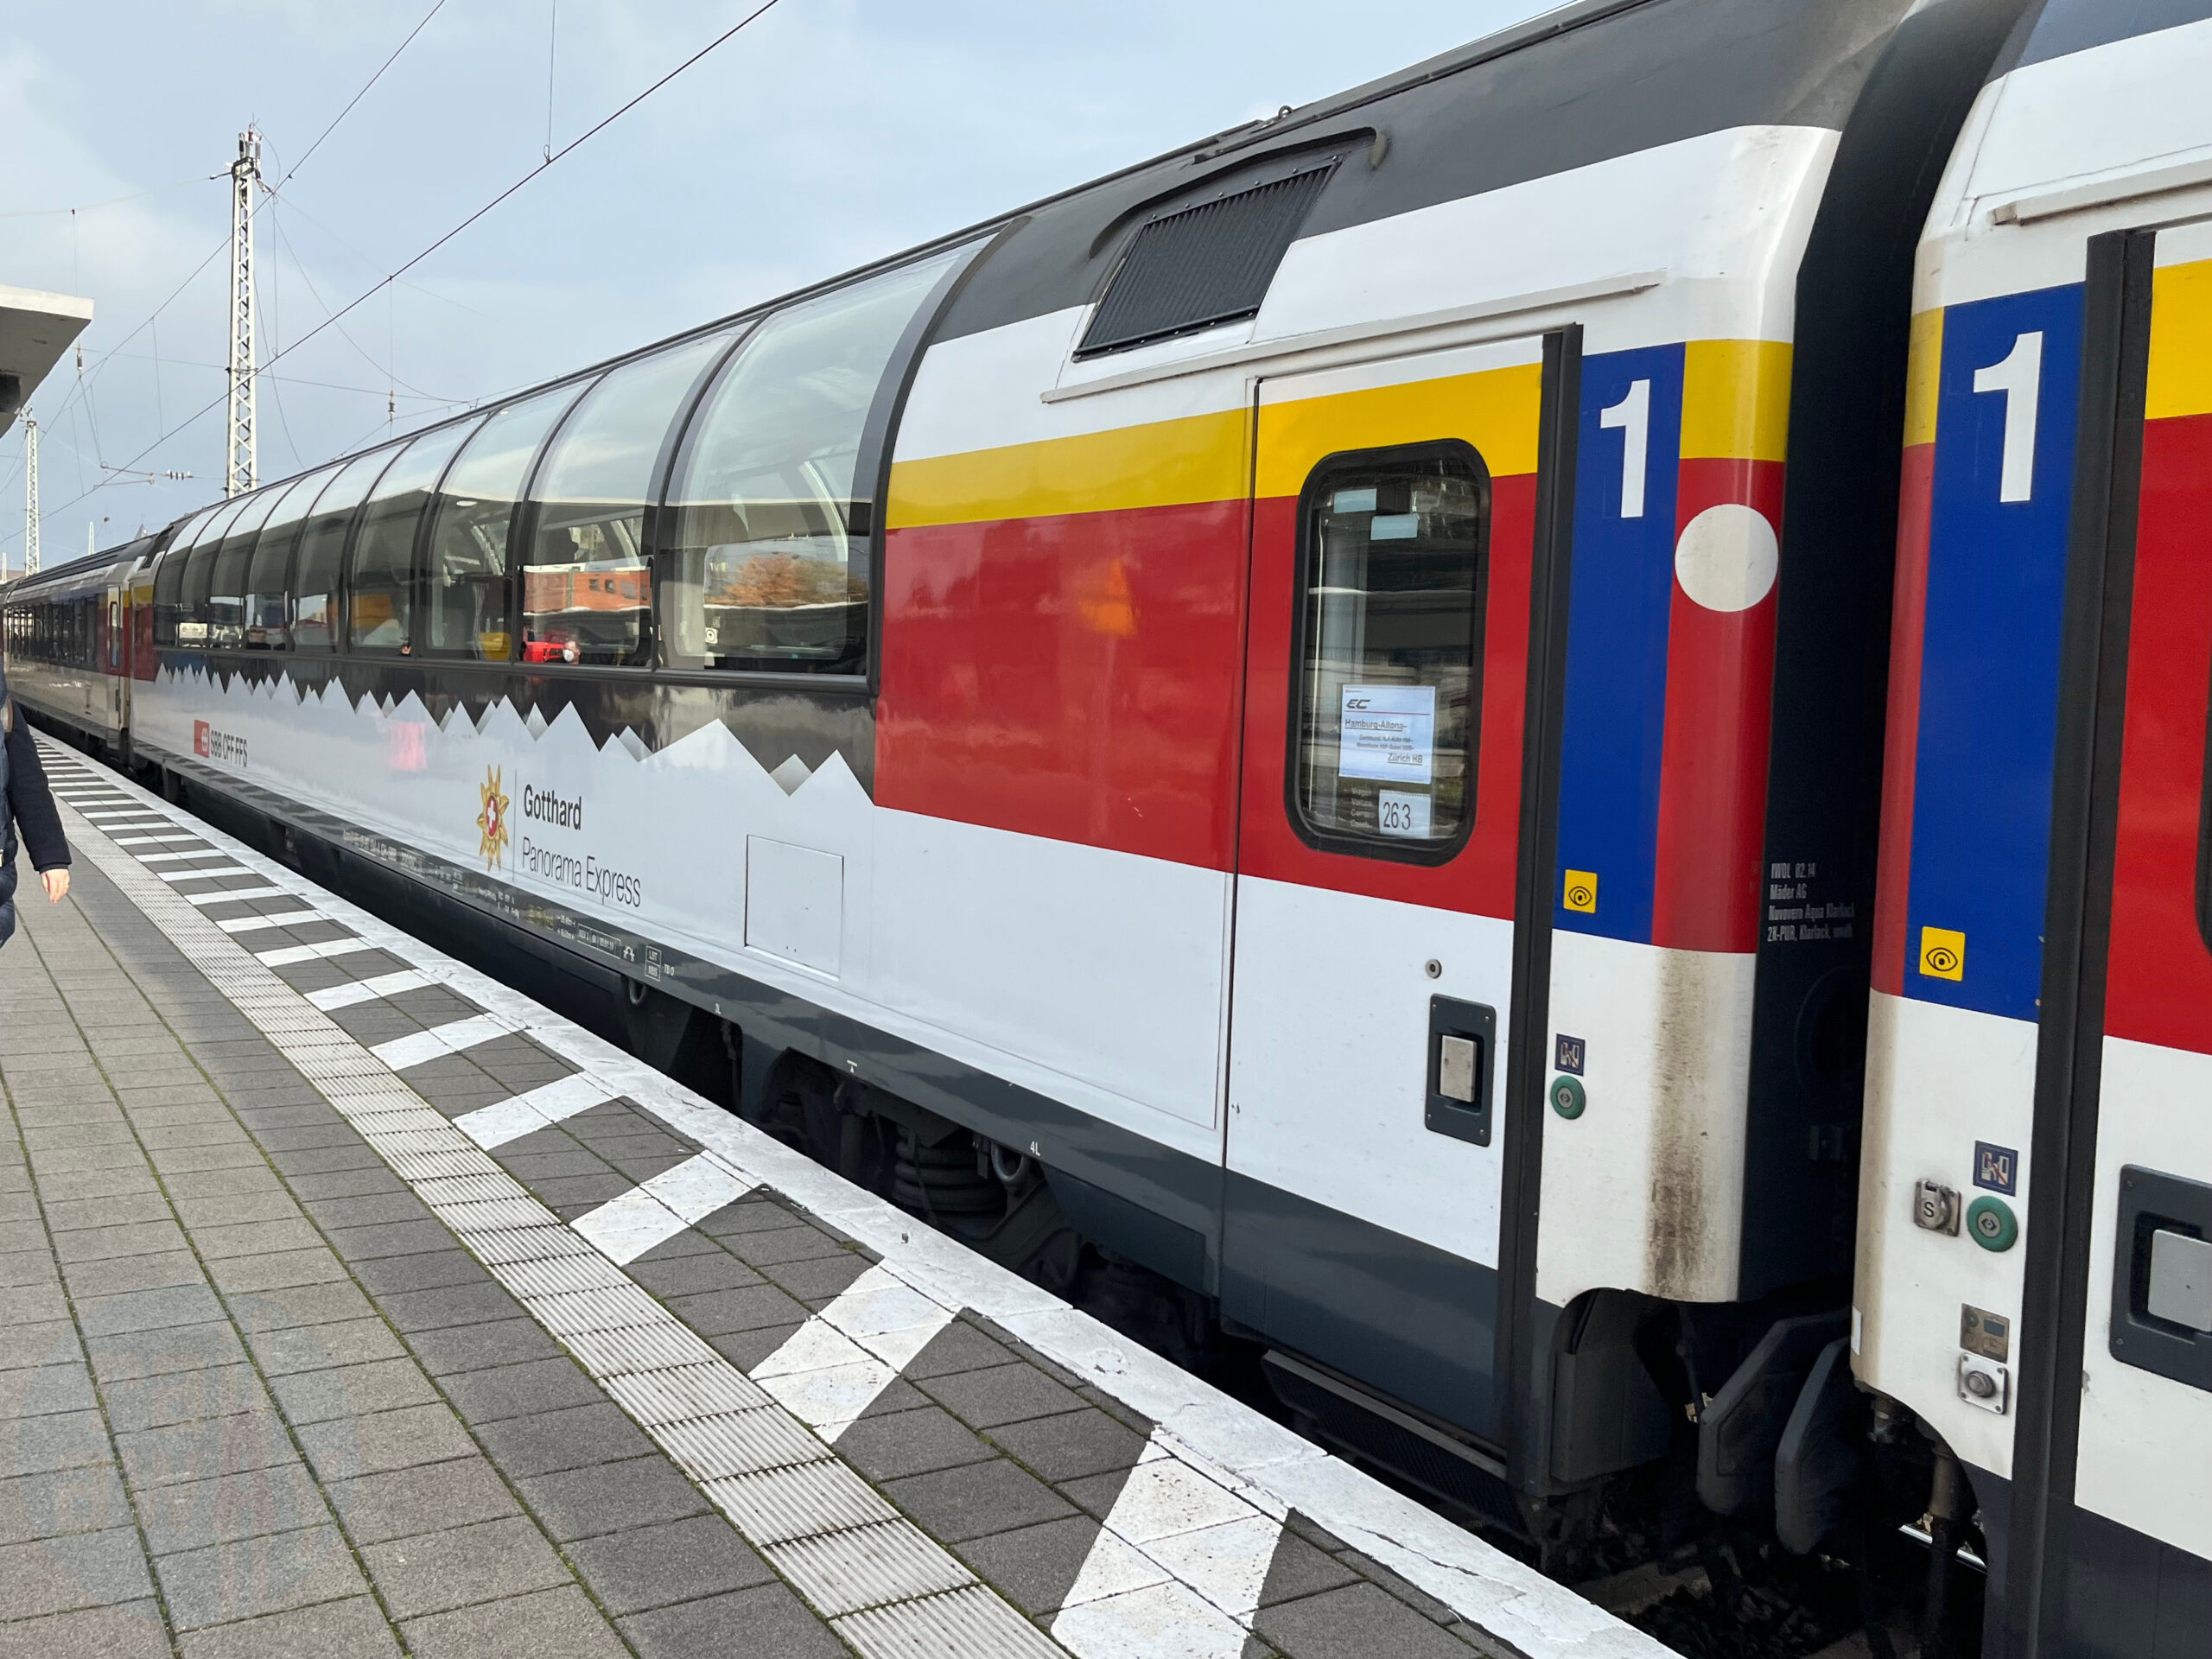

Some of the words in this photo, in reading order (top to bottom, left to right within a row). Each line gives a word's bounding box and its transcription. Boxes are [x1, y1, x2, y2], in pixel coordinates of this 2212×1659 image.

[1973, 330, 2044, 503] 1
[1600, 378, 1650, 518] 1
[1345, 698, 1371, 709] EC
[210, 729, 222, 758] SBB
[235, 737, 248, 767] FFS
[1387, 753, 1410, 763] Zürich
[1412, 754, 1423, 764] HB
[524, 784, 582, 830] Gotthard
[1382, 801, 1411, 830] 263
[522, 836, 582, 888] Panorama
[586, 855, 641, 908] Express
[1796, 883, 1808, 899] AG
[1030, 1141, 1041, 1157] 4L
[1923, 1201, 1934, 1217] S
